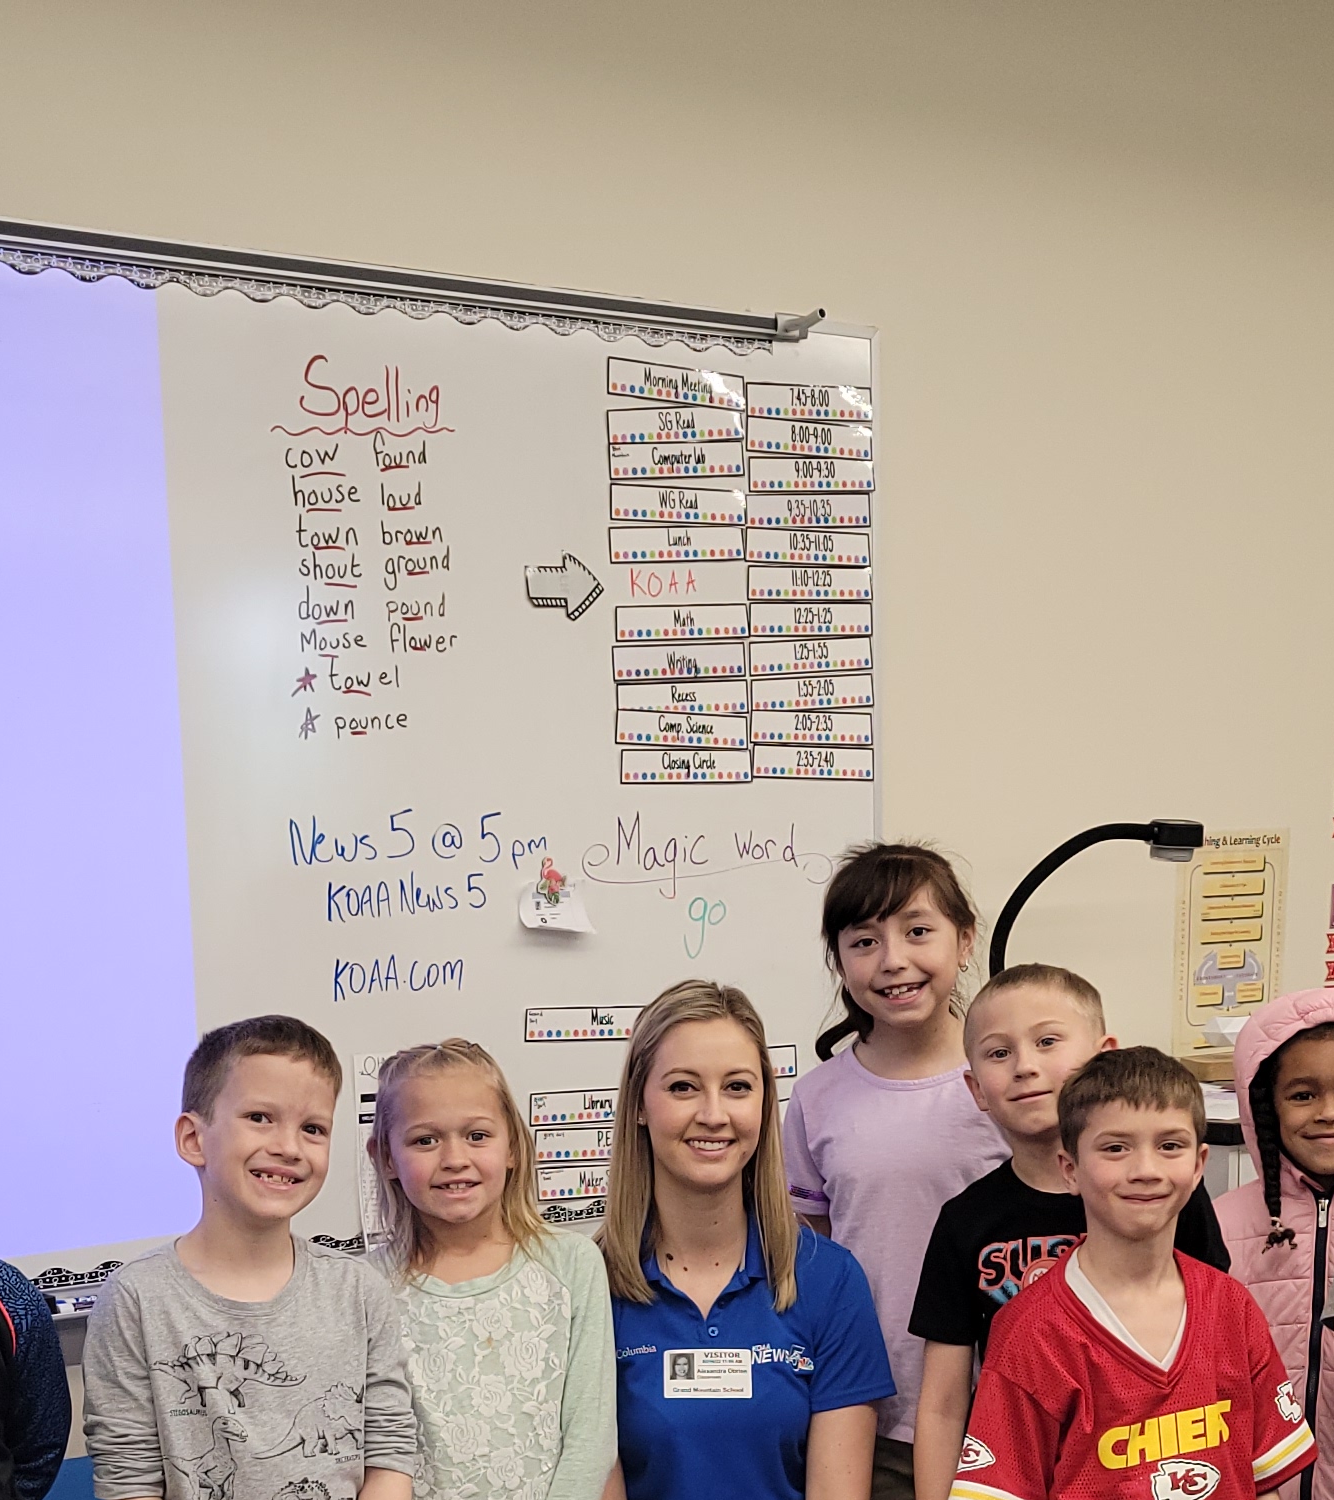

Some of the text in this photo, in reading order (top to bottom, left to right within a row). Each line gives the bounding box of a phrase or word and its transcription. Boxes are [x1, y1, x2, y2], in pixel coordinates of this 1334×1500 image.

[299, 354, 439, 434] Spelling
[644, 367, 713, 403] Morning Meeting
[658, 411, 695, 431] SG Read
[791, 425, 832, 445] 8:00-9:00
[285, 431, 427, 468] cow found
[651, 447, 690, 473] Computer
[794, 461, 835, 479] 9:00-9:30
[292, 474, 422, 508] house loud
[659, 491, 698, 510] WG Read
[787, 499, 832, 518] 9:35-10:35
[296, 514, 443, 548] town brown
[668, 528, 692, 547] Lunch
[789, 533, 834, 552] 10:35-11:05
[299, 545, 450, 591] shout ground
[792, 569, 832, 588] 11:10-12:25
[630, 568, 697, 597] KOAA
[298, 585, 445, 621] down pound
[673, 610, 695, 628] Math
[793, 607, 833, 625] 12:25-1:25
[390, 622, 457, 653] flower
[793, 642, 829, 660] 1:25-1:55
[329, 657, 399, 690] towel
[667, 651, 697, 677] Writing
[671, 685, 696, 703] Recess
[797, 679, 835, 698] 1:55-2:05
[335, 712, 408, 739] pounce
[658, 716, 714, 741] Comp. Science
[794, 714, 833, 732] 2:05-2:35
[662, 752, 716, 778] Closing Circle
[796, 751, 835, 768] 2:35-2:40
[289, 809, 547, 869] News 5 @ 5 pm
[1222, 836, 1228, 845] &
[1229, 835, 1261, 848] Learning
[1262, 834, 1281, 847] Cycle
[615, 812, 709, 898] Magic
[327, 871, 487, 923] KOAA News 5
[683, 896, 727, 958] go
[591, 1008, 614, 1026] Music
[583, 1094, 613, 1118] Library
[579, 1171, 604, 1188] Maker
[616, 1344, 657, 1360] Columbia
